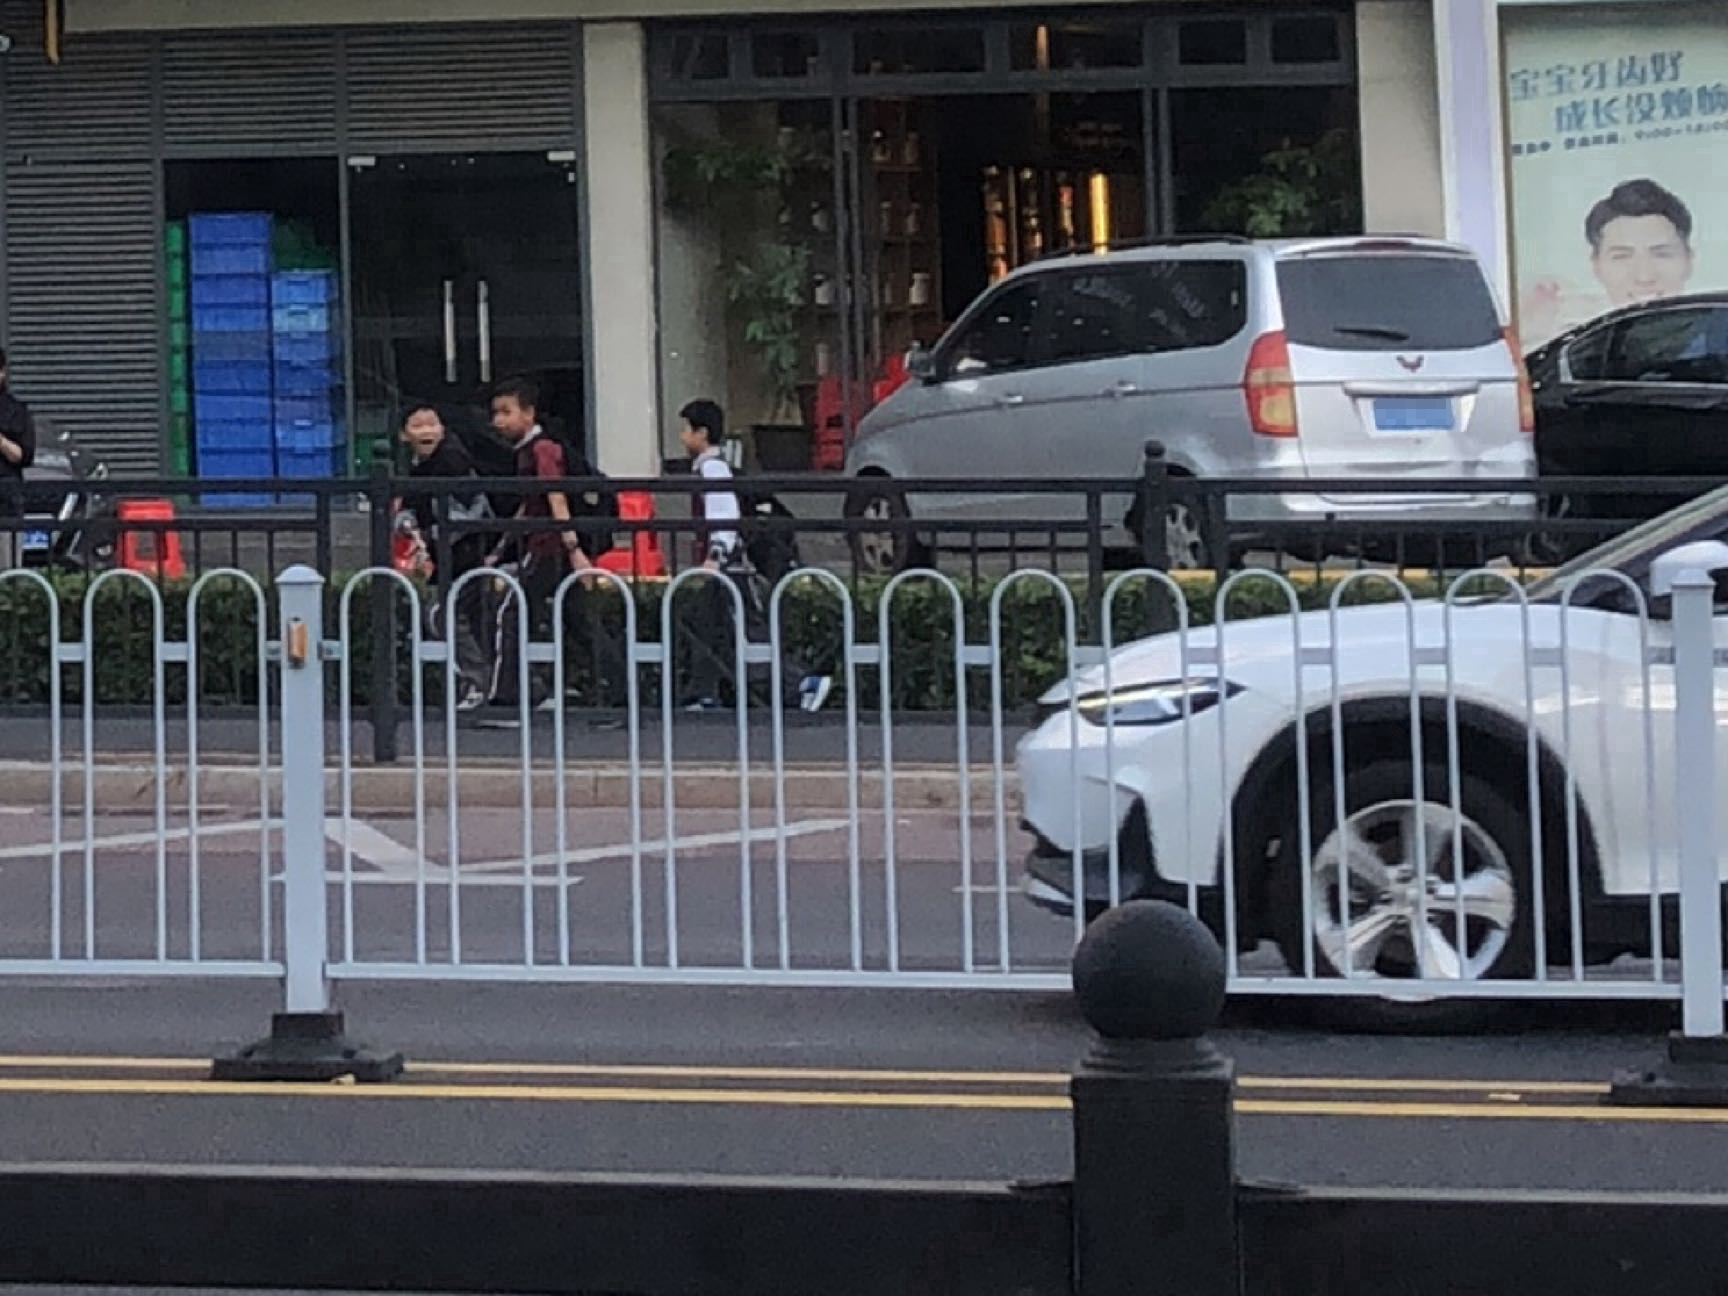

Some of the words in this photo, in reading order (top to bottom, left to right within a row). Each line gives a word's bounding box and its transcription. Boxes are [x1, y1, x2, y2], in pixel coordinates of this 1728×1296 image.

[1511, 50, 1684, 101] 宝宝牙齿好
